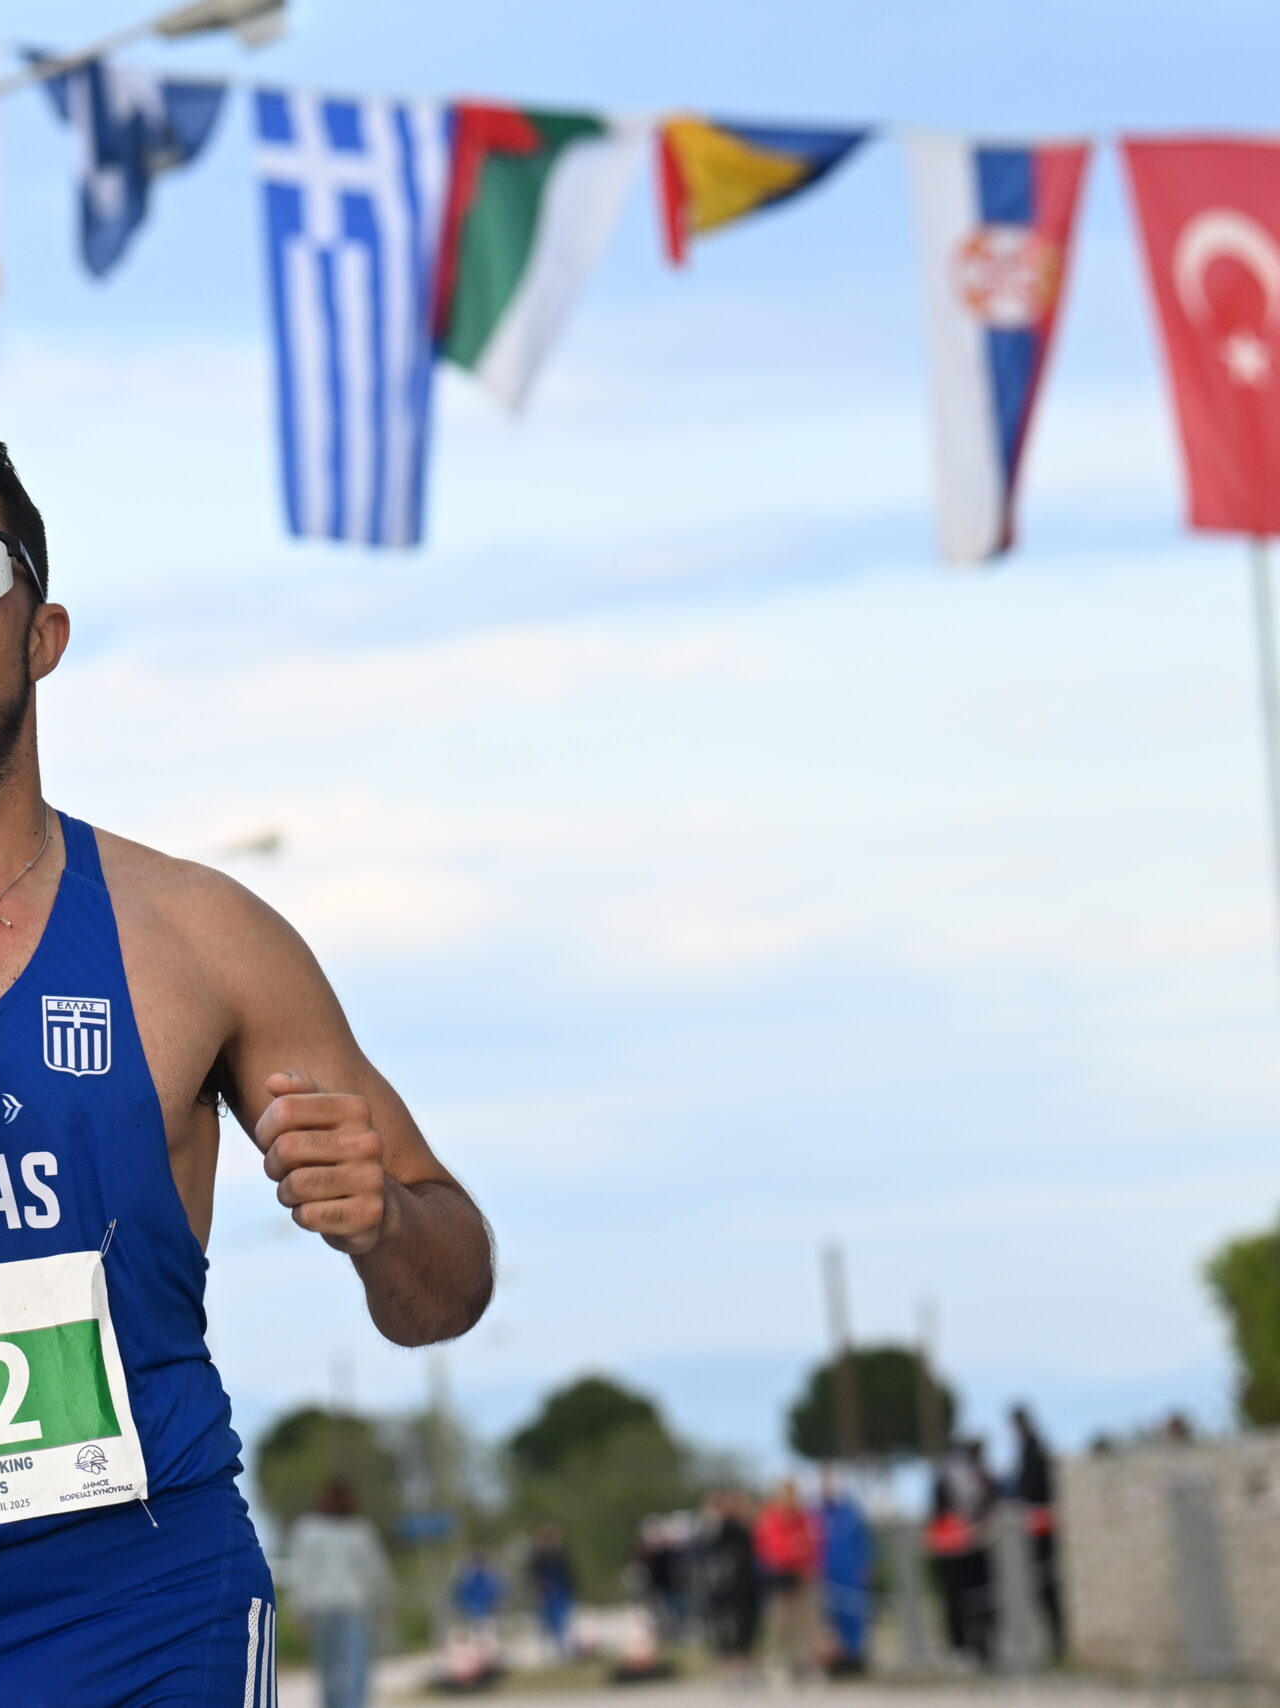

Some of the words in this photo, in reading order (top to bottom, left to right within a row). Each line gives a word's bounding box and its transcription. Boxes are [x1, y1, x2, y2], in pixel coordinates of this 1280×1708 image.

[57, 1002, 96, 1012] ΕΛΛΑΣ
[82, 1479, 110, 1489] ΔΗΜΟΣ
[10, 1498, 31, 1510] 2025
